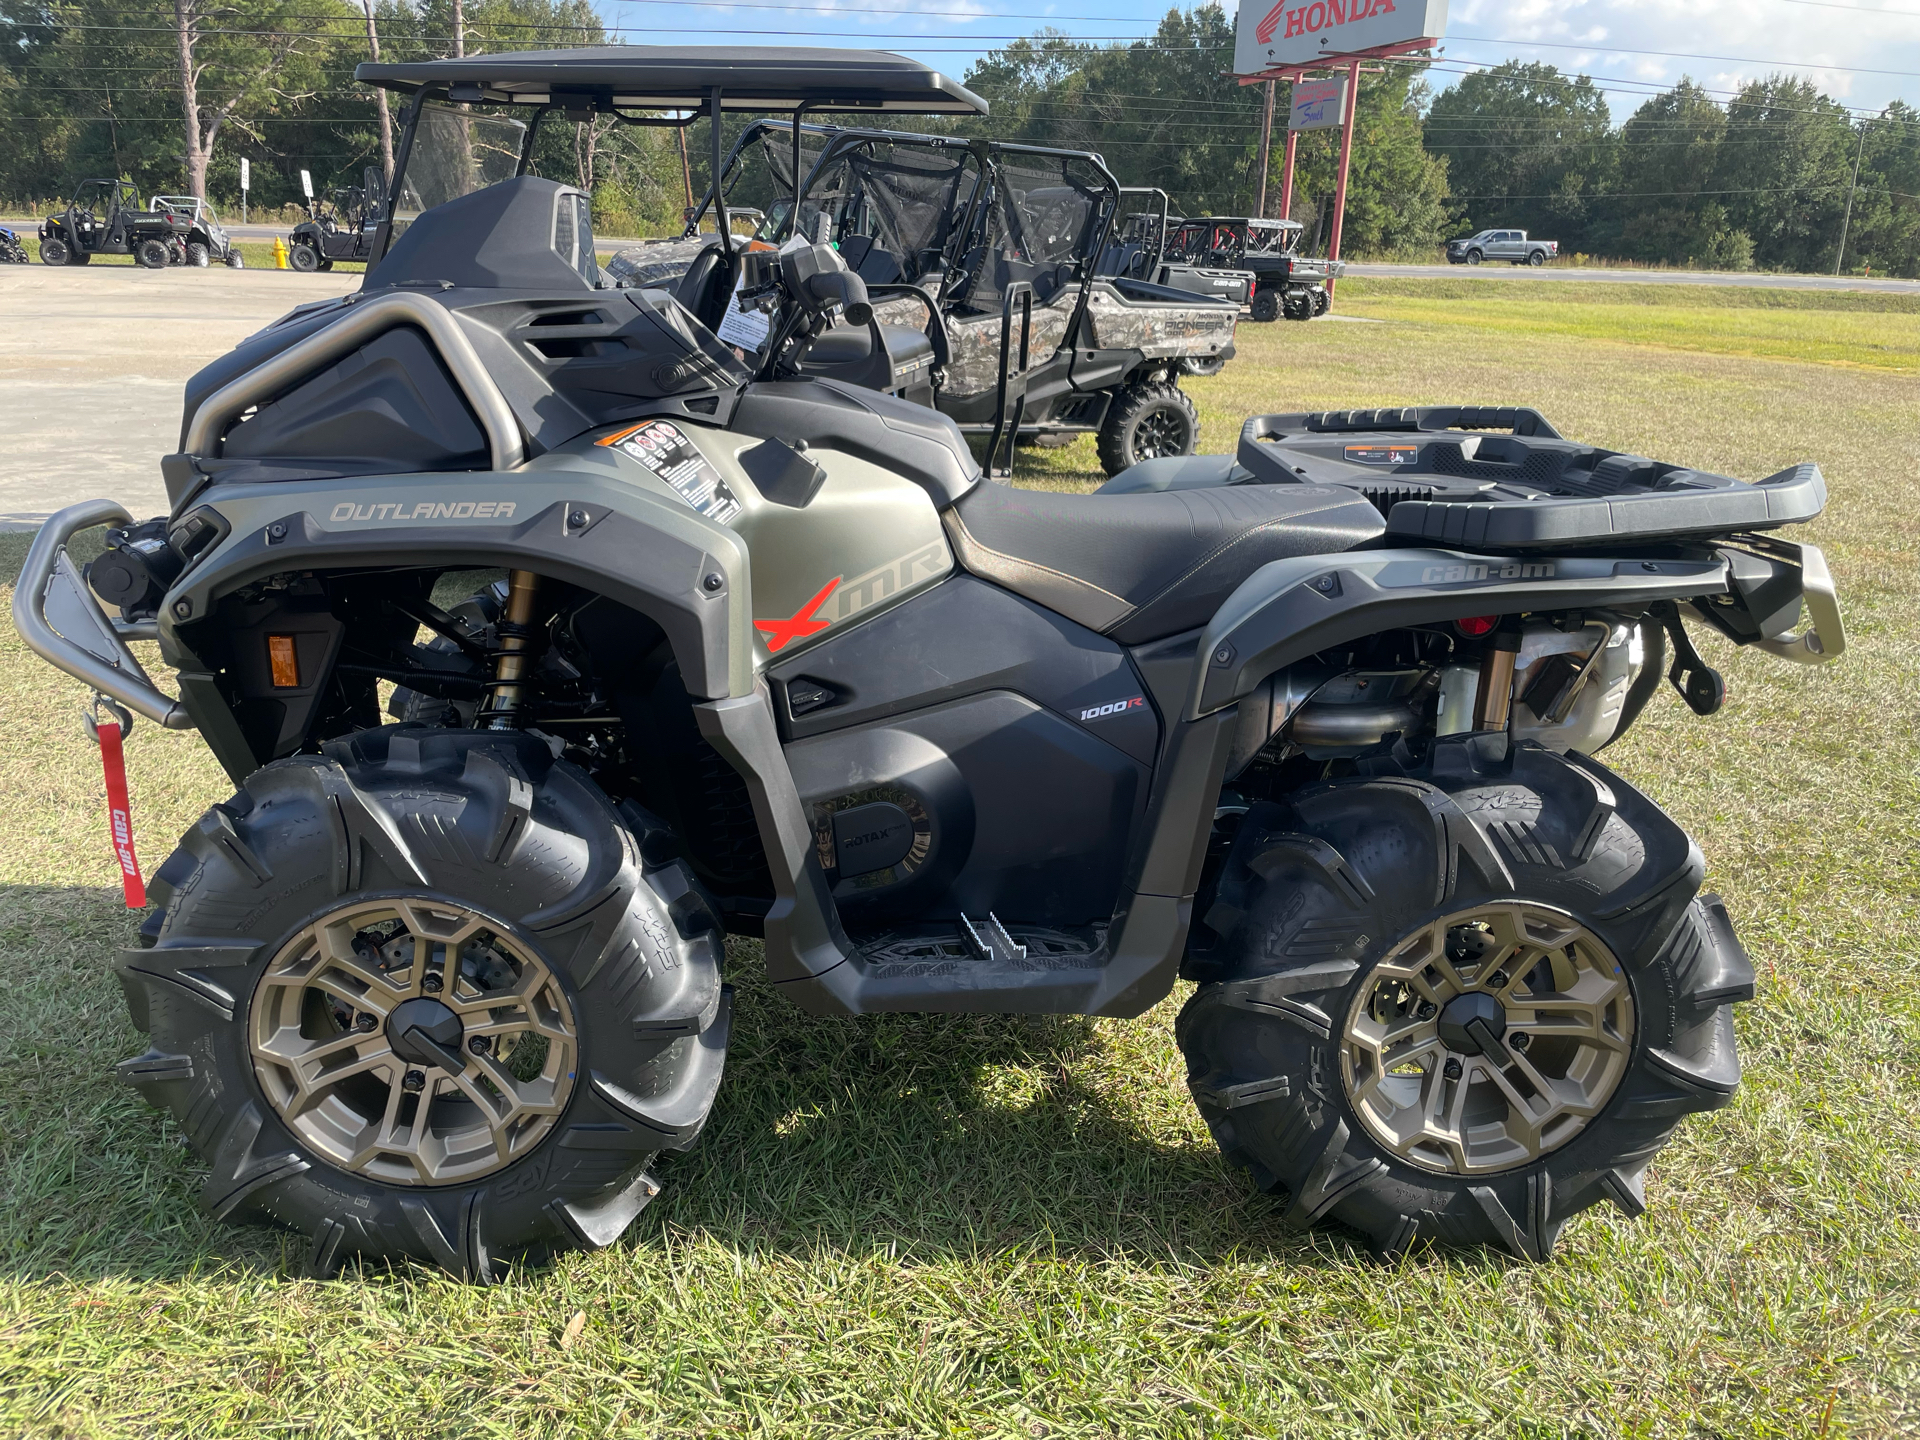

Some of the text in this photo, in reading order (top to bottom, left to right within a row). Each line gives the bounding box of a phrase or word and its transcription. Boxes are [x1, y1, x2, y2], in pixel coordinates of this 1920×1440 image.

[1284, 0, 1396, 39] HONDA
[1164, 321, 1225, 330] PIONEER
[329, 502, 517, 522] OUTLANDER
[1420, 562, 1556, 584] can-am
[1080, 697, 1143, 721] 1000R
[113, 808, 136, 877] can-am
[843, 828, 890, 849] ROTAX
